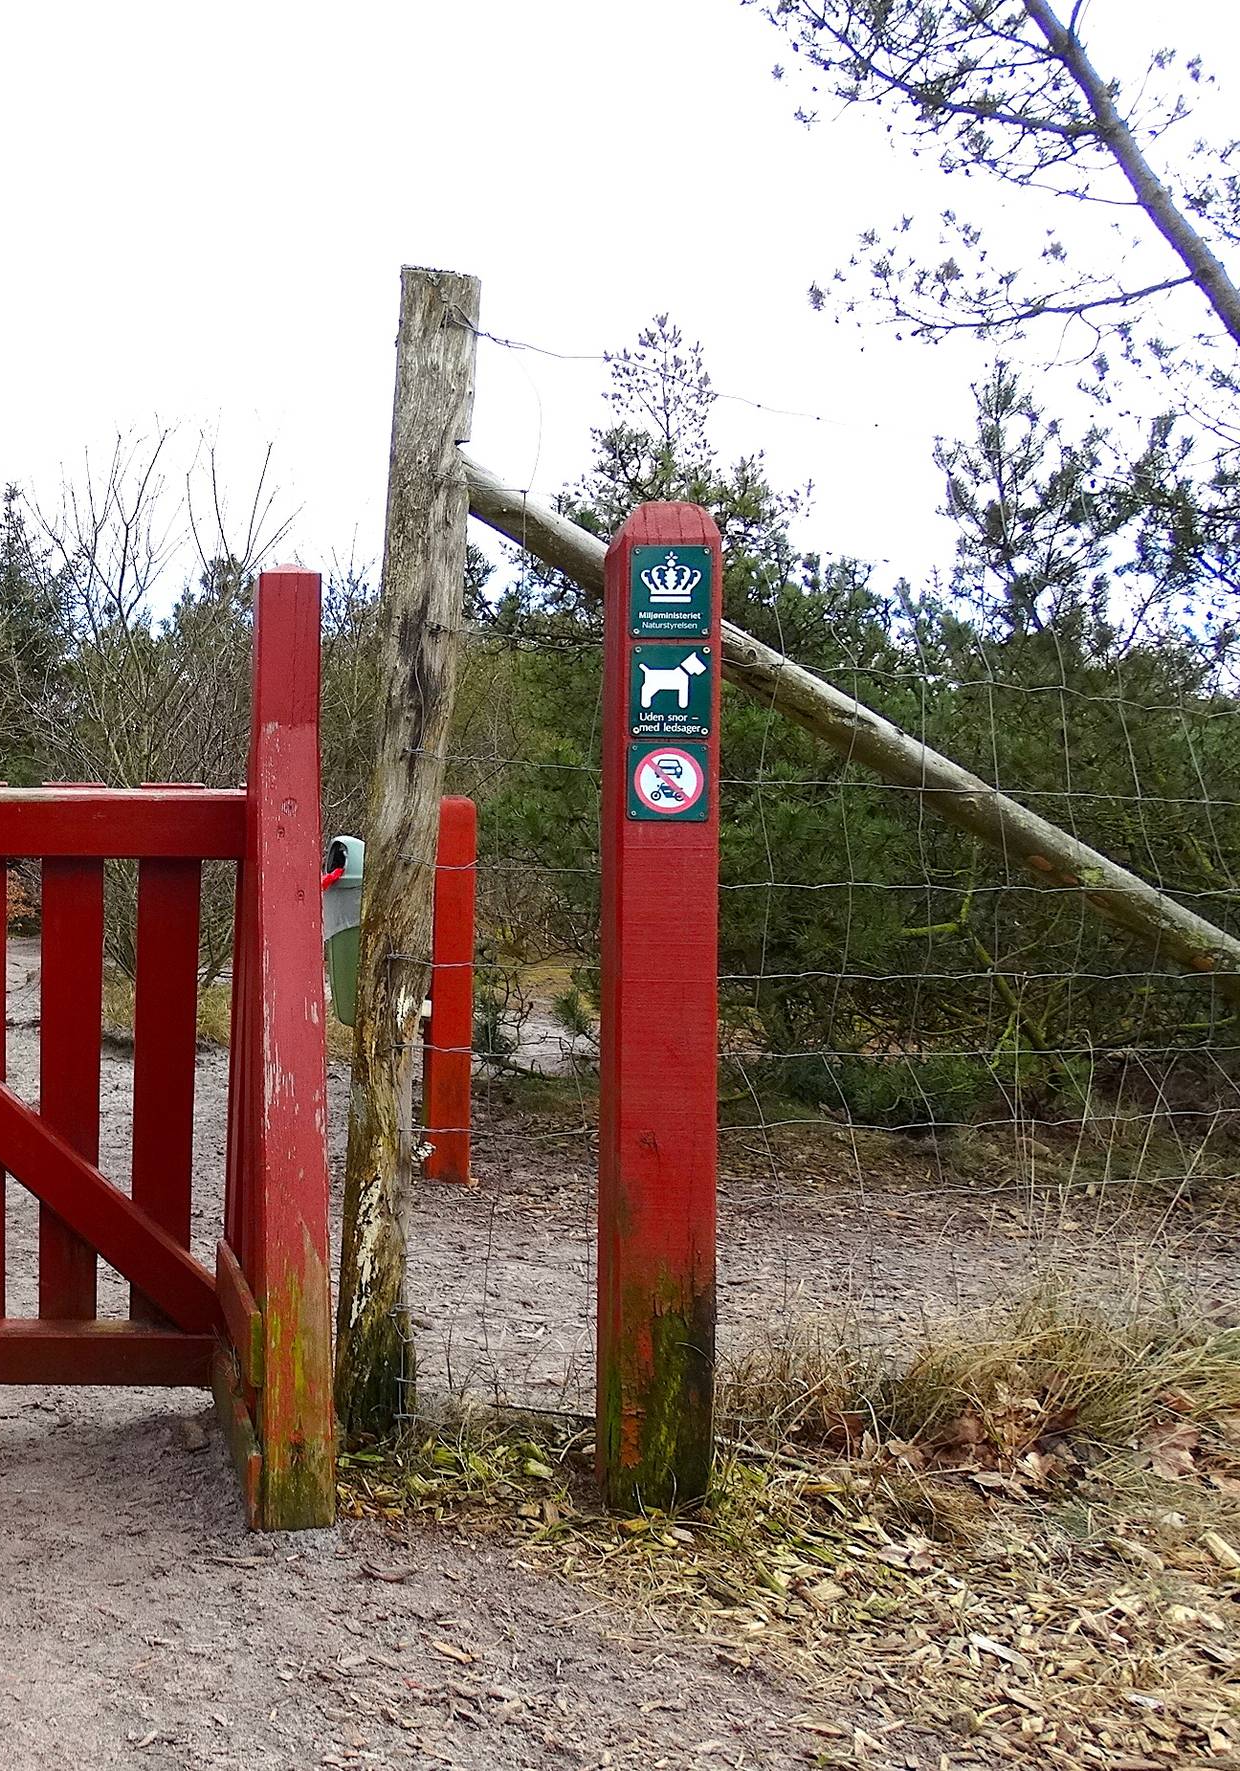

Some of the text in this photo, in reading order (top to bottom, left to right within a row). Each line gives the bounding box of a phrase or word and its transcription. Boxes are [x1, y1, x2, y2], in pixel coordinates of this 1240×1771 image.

[639, 612, 701, 620] Miljøministeriet
[640, 712, 664, 721] Uden
[640, 723, 701, 734] med ledsager
